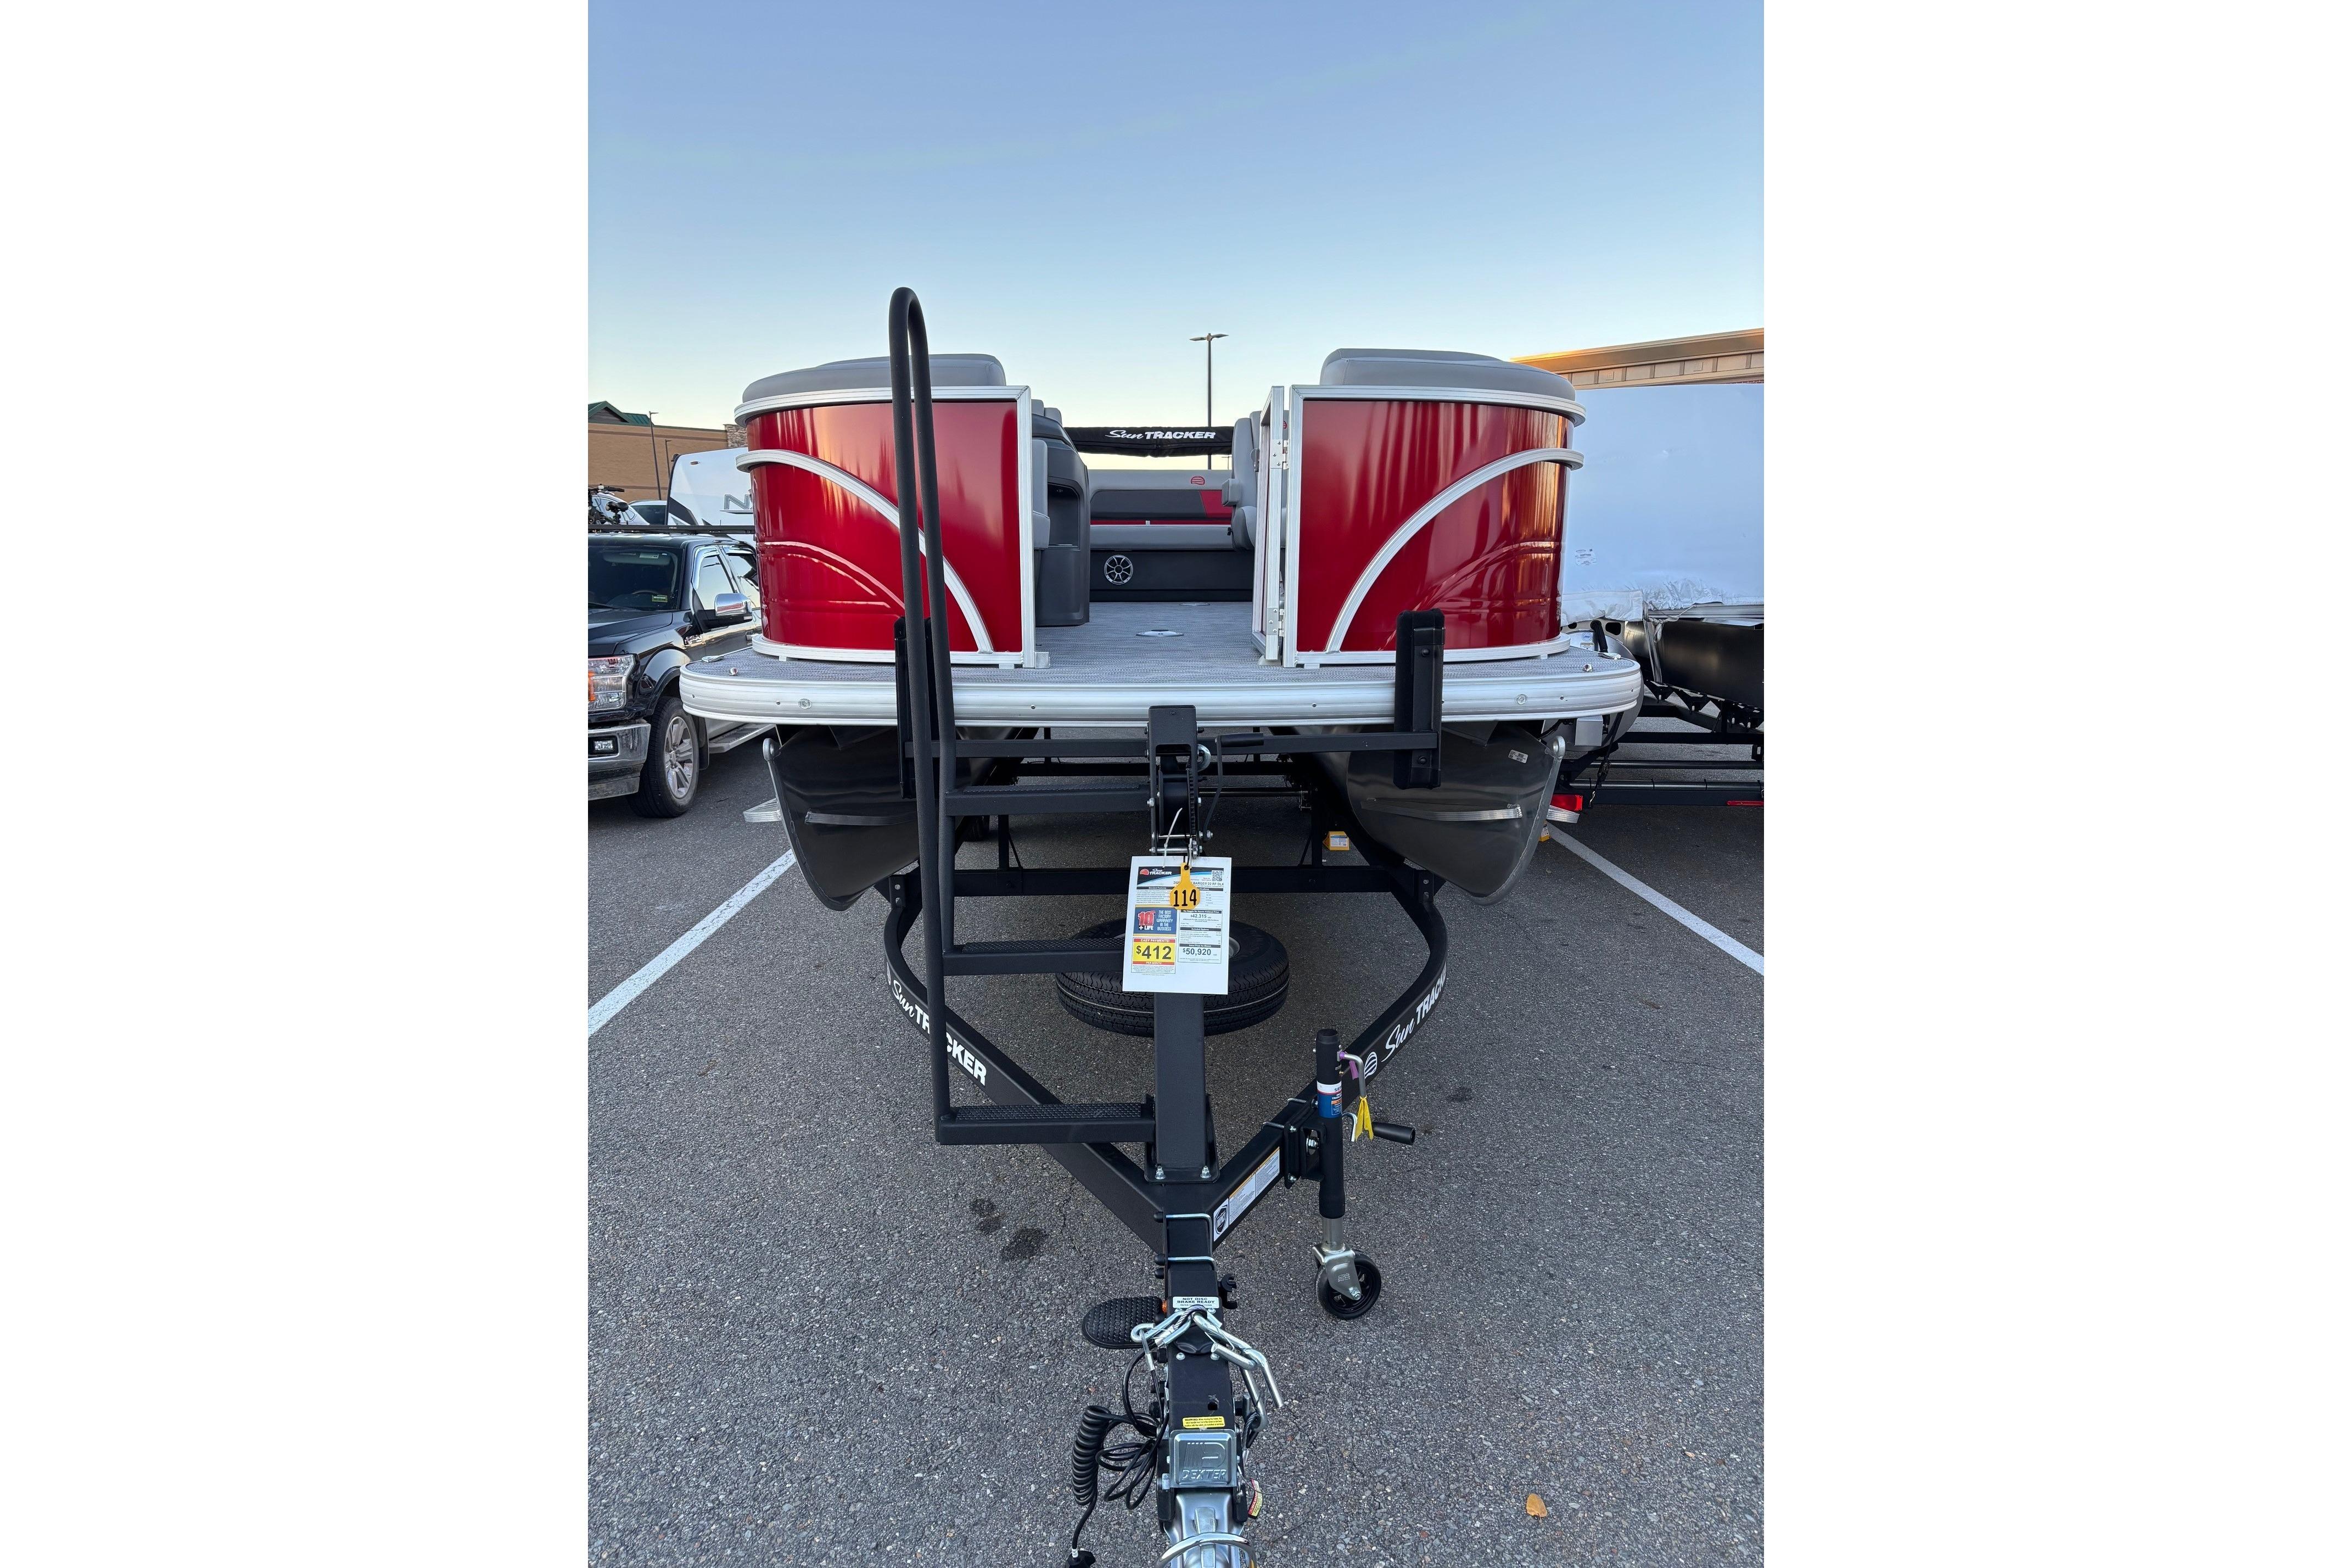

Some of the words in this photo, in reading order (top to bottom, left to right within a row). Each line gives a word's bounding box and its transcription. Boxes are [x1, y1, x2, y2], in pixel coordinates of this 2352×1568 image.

[1105, 430, 1144, 439] Sun
[1145, 431, 1216, 439] TRACKER
[1173, 889, 1197, 907] 114
[1136, 945, 1171, 959] $412
[891, 979, 915, 1017] Sun
[915, 1004, 987, 1086] TRCKER
[1381, 1018, 1415, 1062] Sun
[1180, 1469, 1227, 1480] DEXTER
